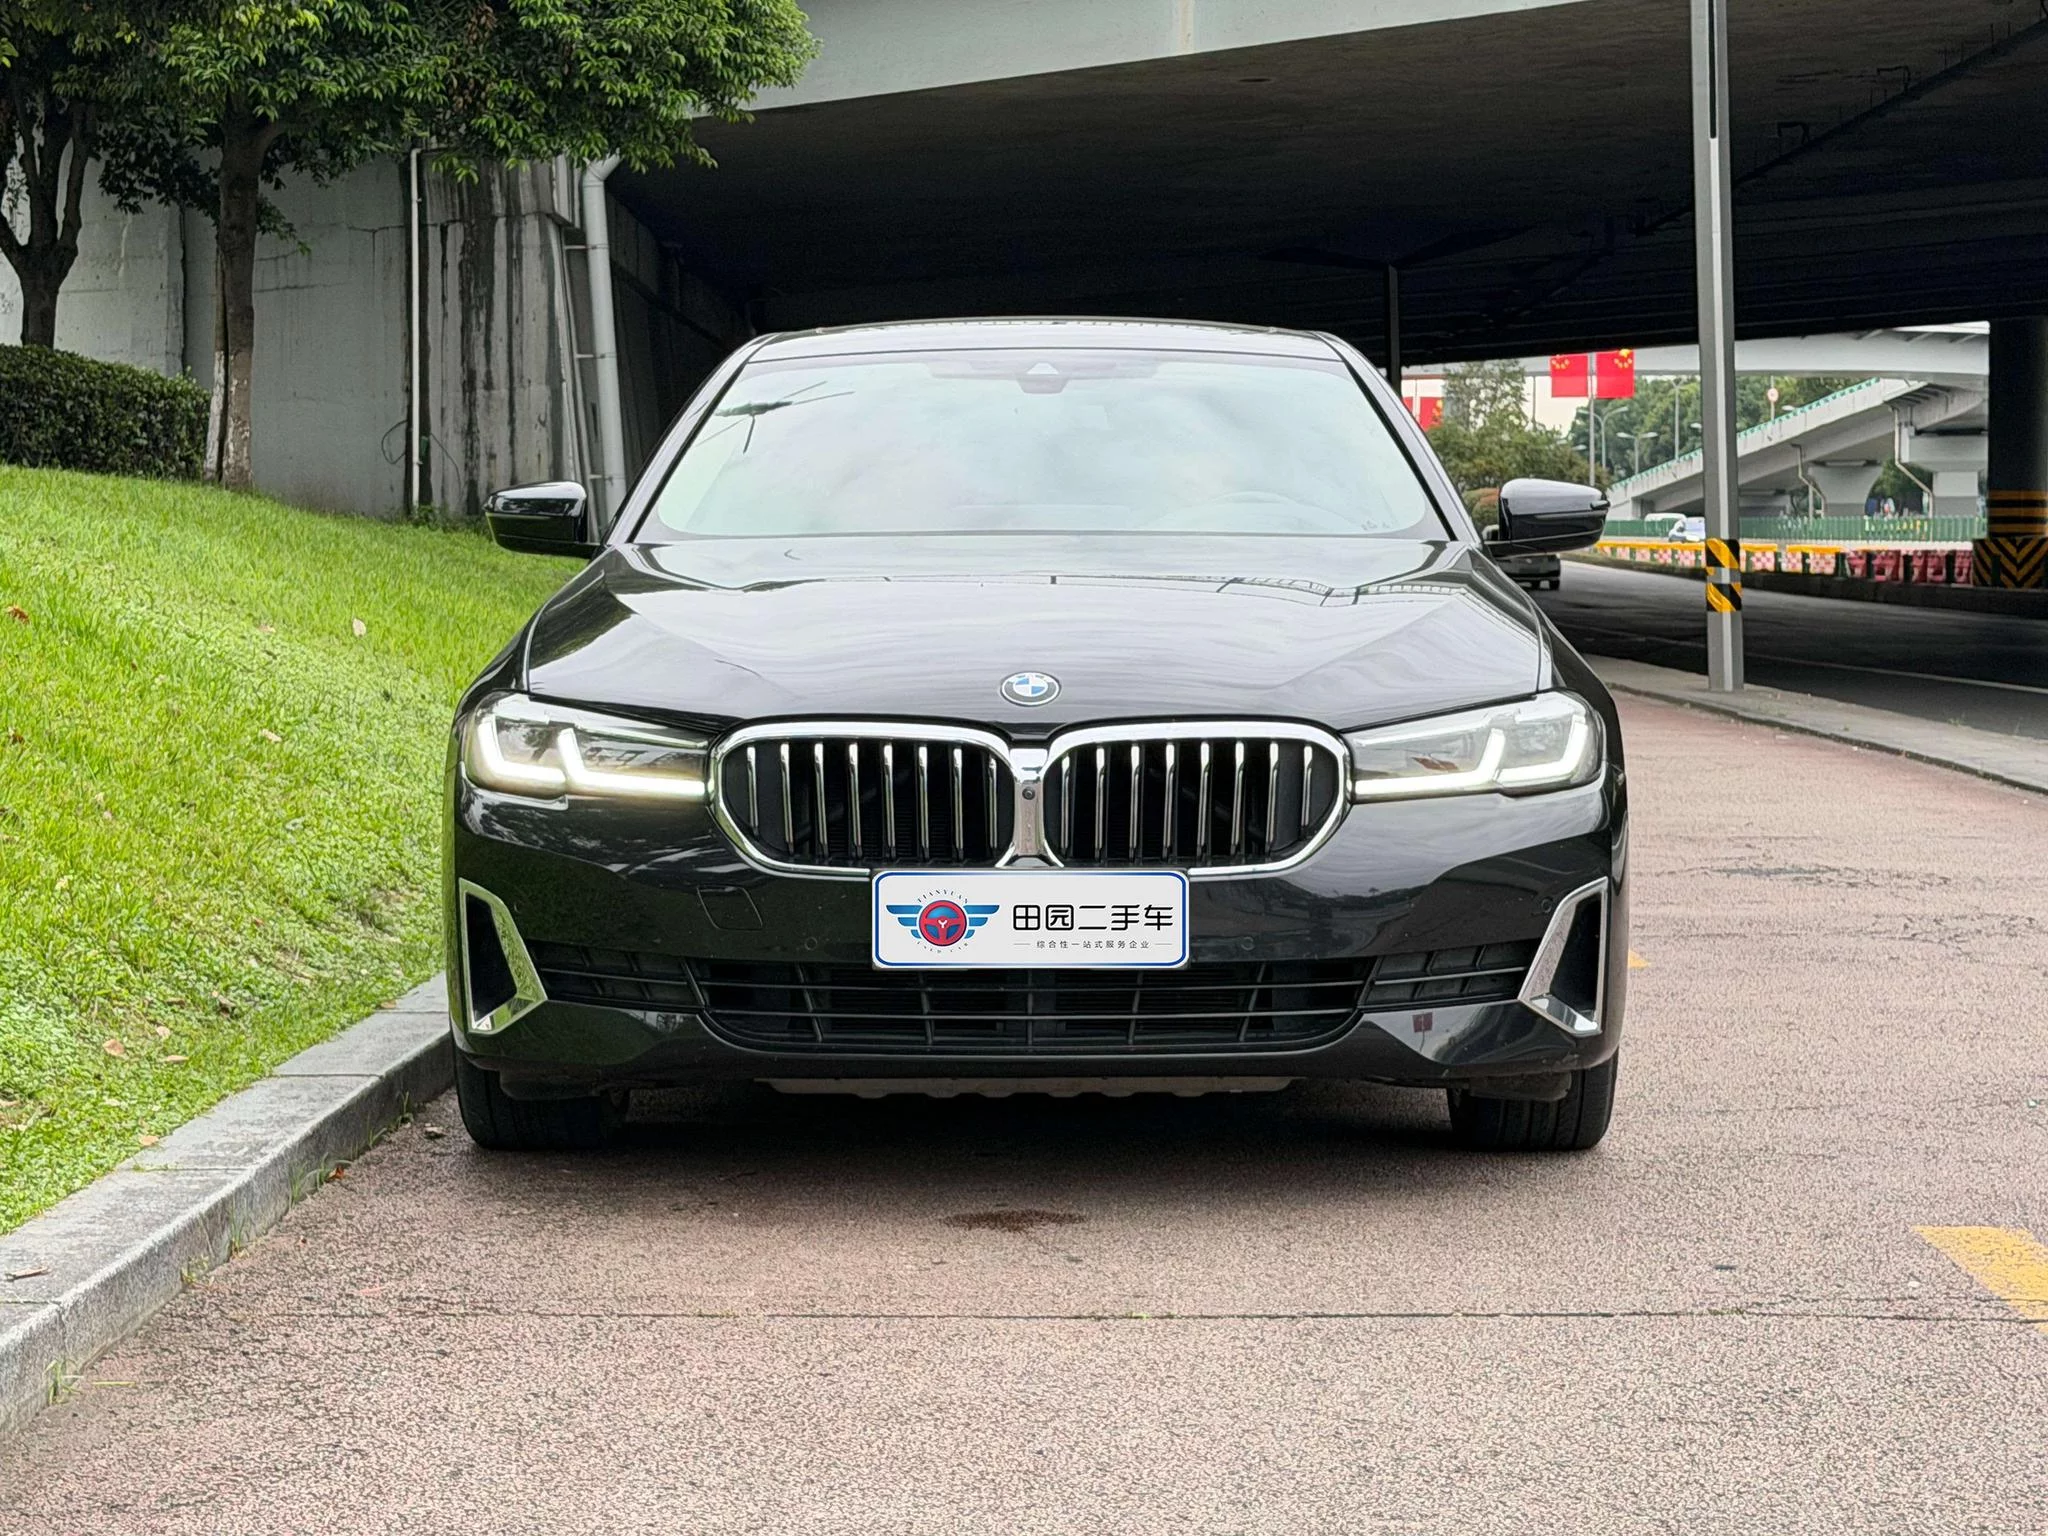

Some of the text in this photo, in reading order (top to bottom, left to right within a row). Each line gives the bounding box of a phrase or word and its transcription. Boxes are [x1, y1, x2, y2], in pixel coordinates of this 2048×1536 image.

[1012, 904, 1174, 931] 田园二手车
[1036, 940, 1150, 949] 综合性一站式服务企业
